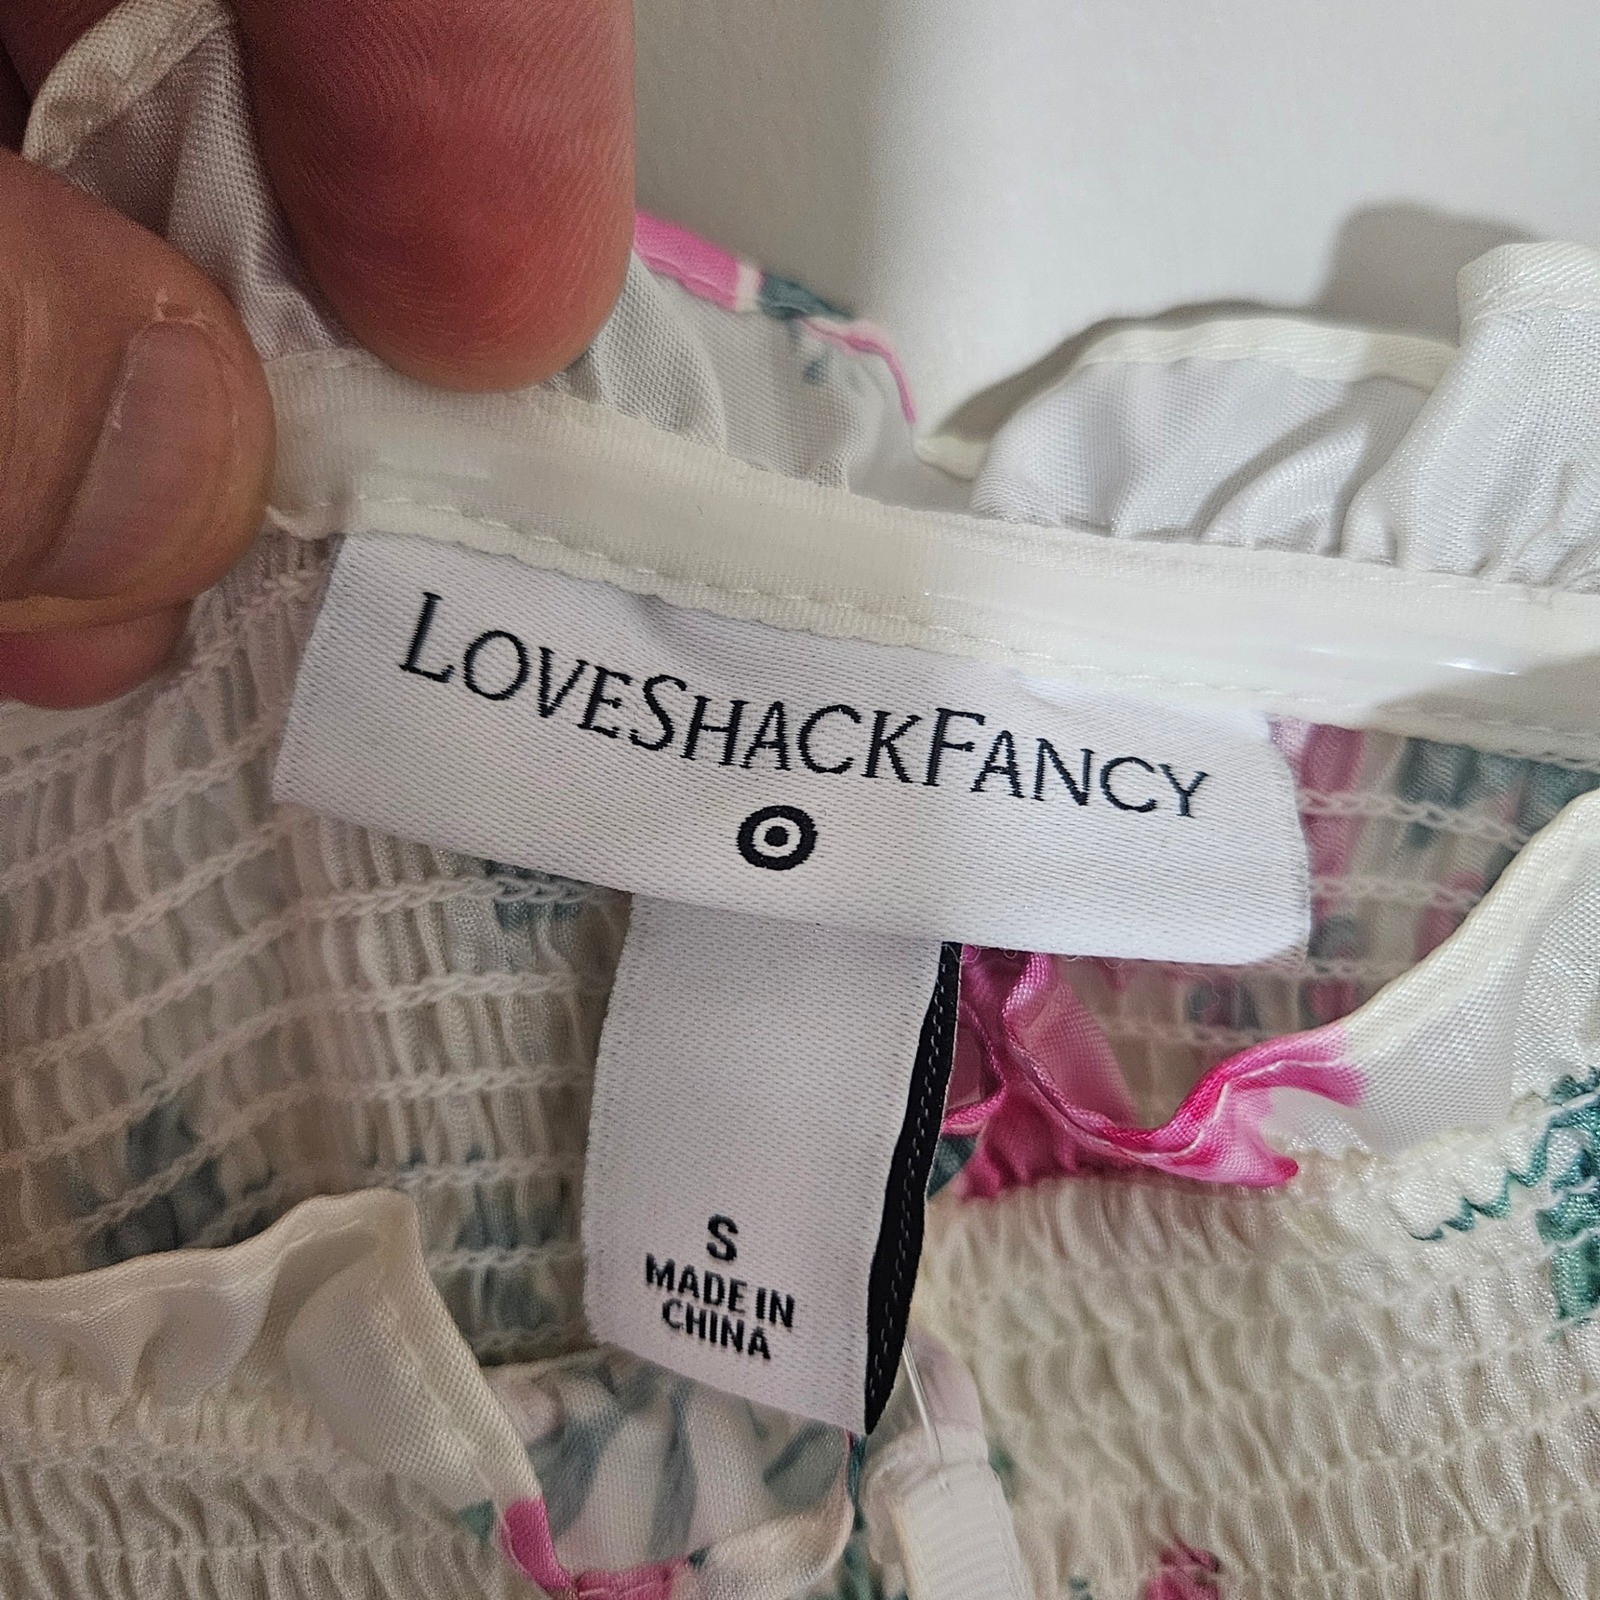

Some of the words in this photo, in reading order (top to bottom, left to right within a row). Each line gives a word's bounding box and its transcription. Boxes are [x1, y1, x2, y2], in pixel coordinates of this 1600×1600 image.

[706, 1213, 739, 1262] S
[645, 1252, 748, 1314] MADE
[756, 1286, 796, 1329] IN
[662, 1298, 771, 1360] CHINA
